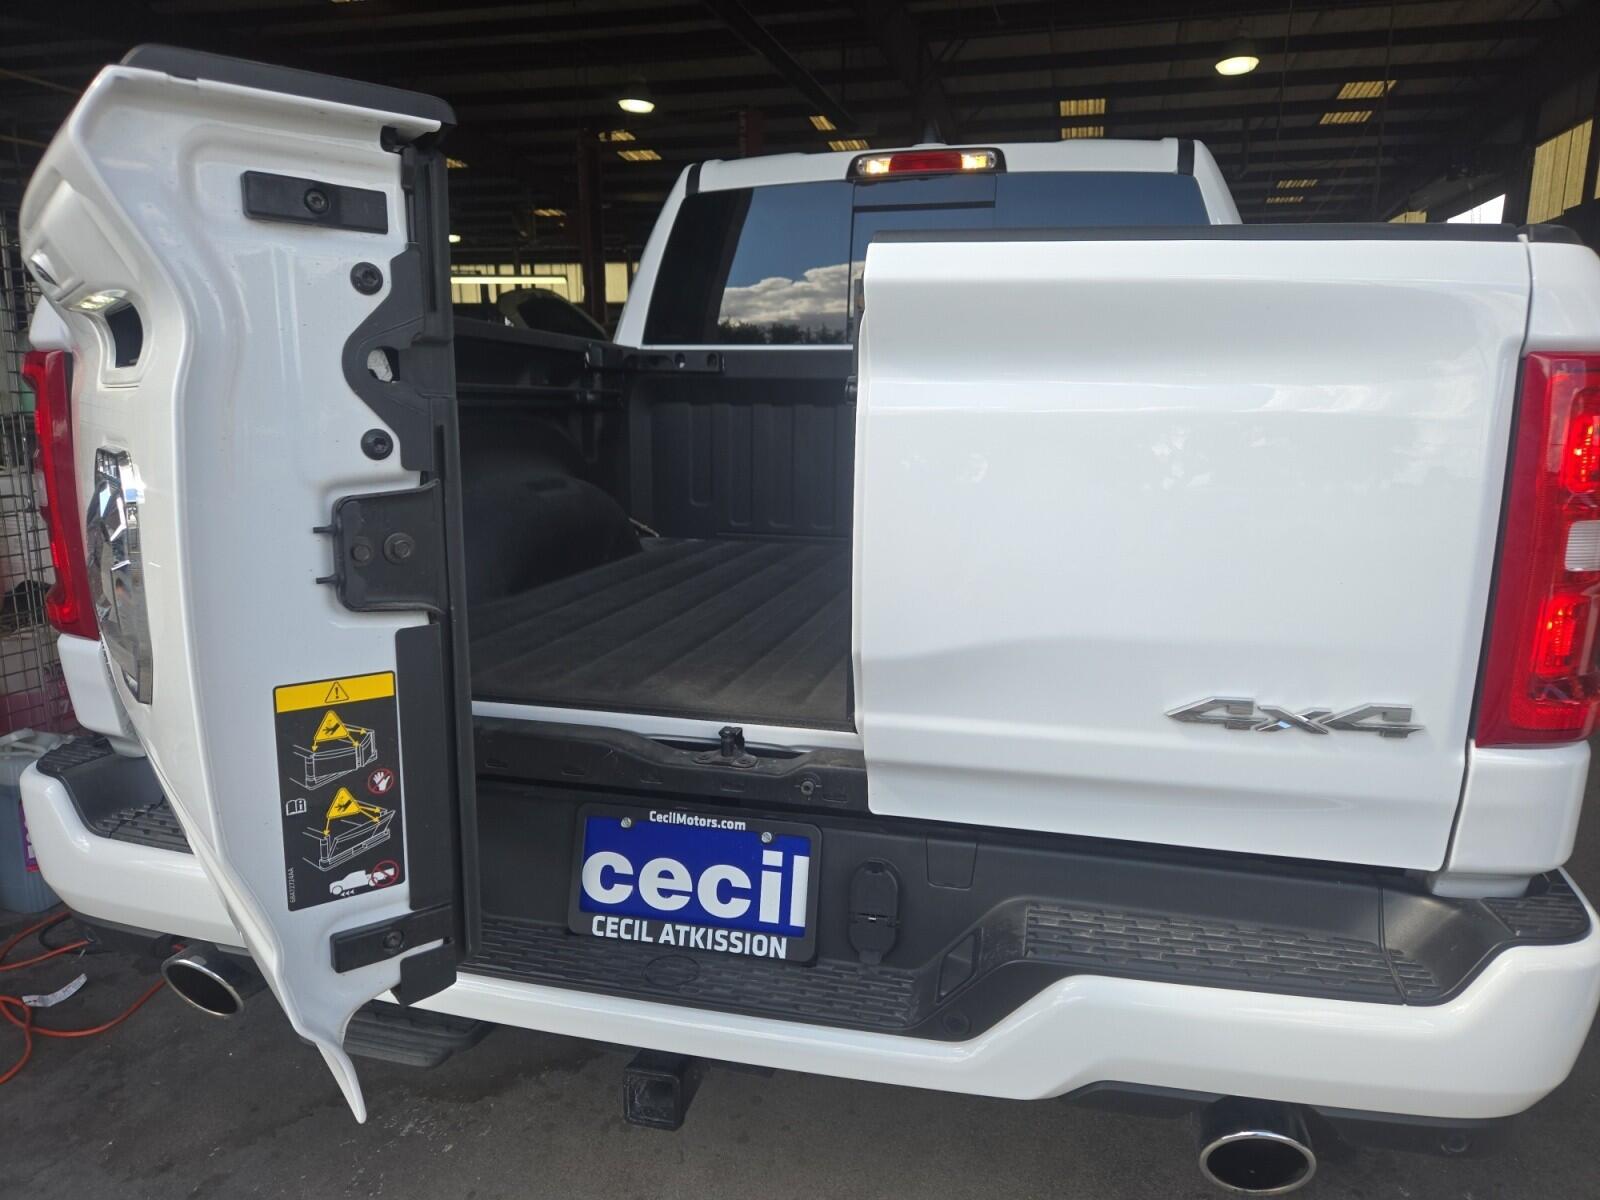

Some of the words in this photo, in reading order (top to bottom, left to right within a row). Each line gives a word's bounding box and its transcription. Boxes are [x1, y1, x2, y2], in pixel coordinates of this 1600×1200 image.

[649, 810, 746, 831] CecilMotors.com
[582, 850, 810, 928] cecil
[591, 915, 654, 943] CECIL
[658, 923, 787, 960] ATKISSION
